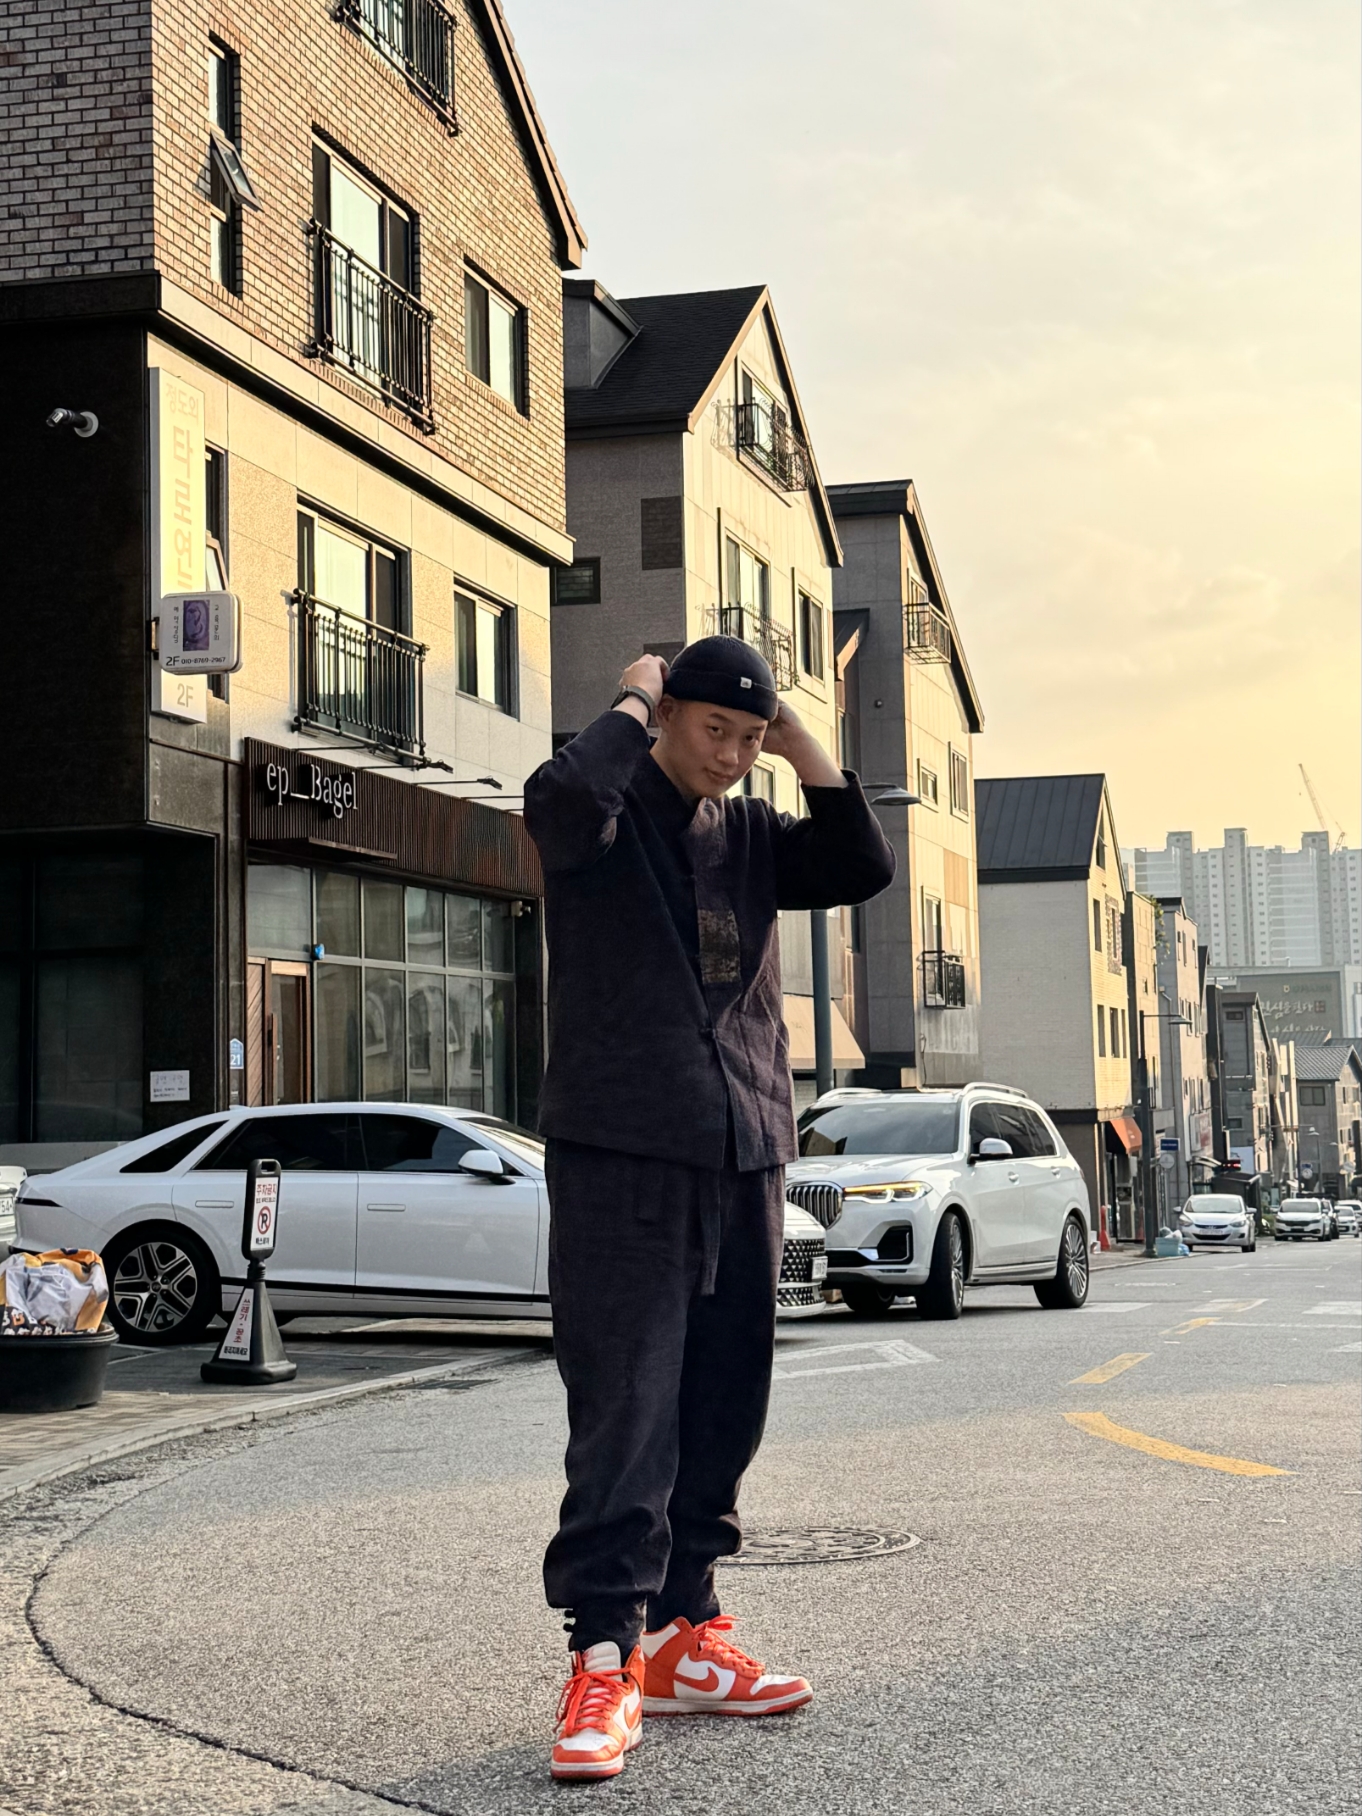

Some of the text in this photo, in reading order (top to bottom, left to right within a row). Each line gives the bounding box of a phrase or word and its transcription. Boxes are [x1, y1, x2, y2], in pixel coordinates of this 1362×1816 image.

[173, 425, 193, 591] 타로연
[166, 656, 180, 667] 2F
[177, 683, 194, 708] 2F
[266, 763, 358, 819] ep_Bagel
[230, 1054, 241, 1066] 21
[256, 1184, 277, 1197] 주차금지
